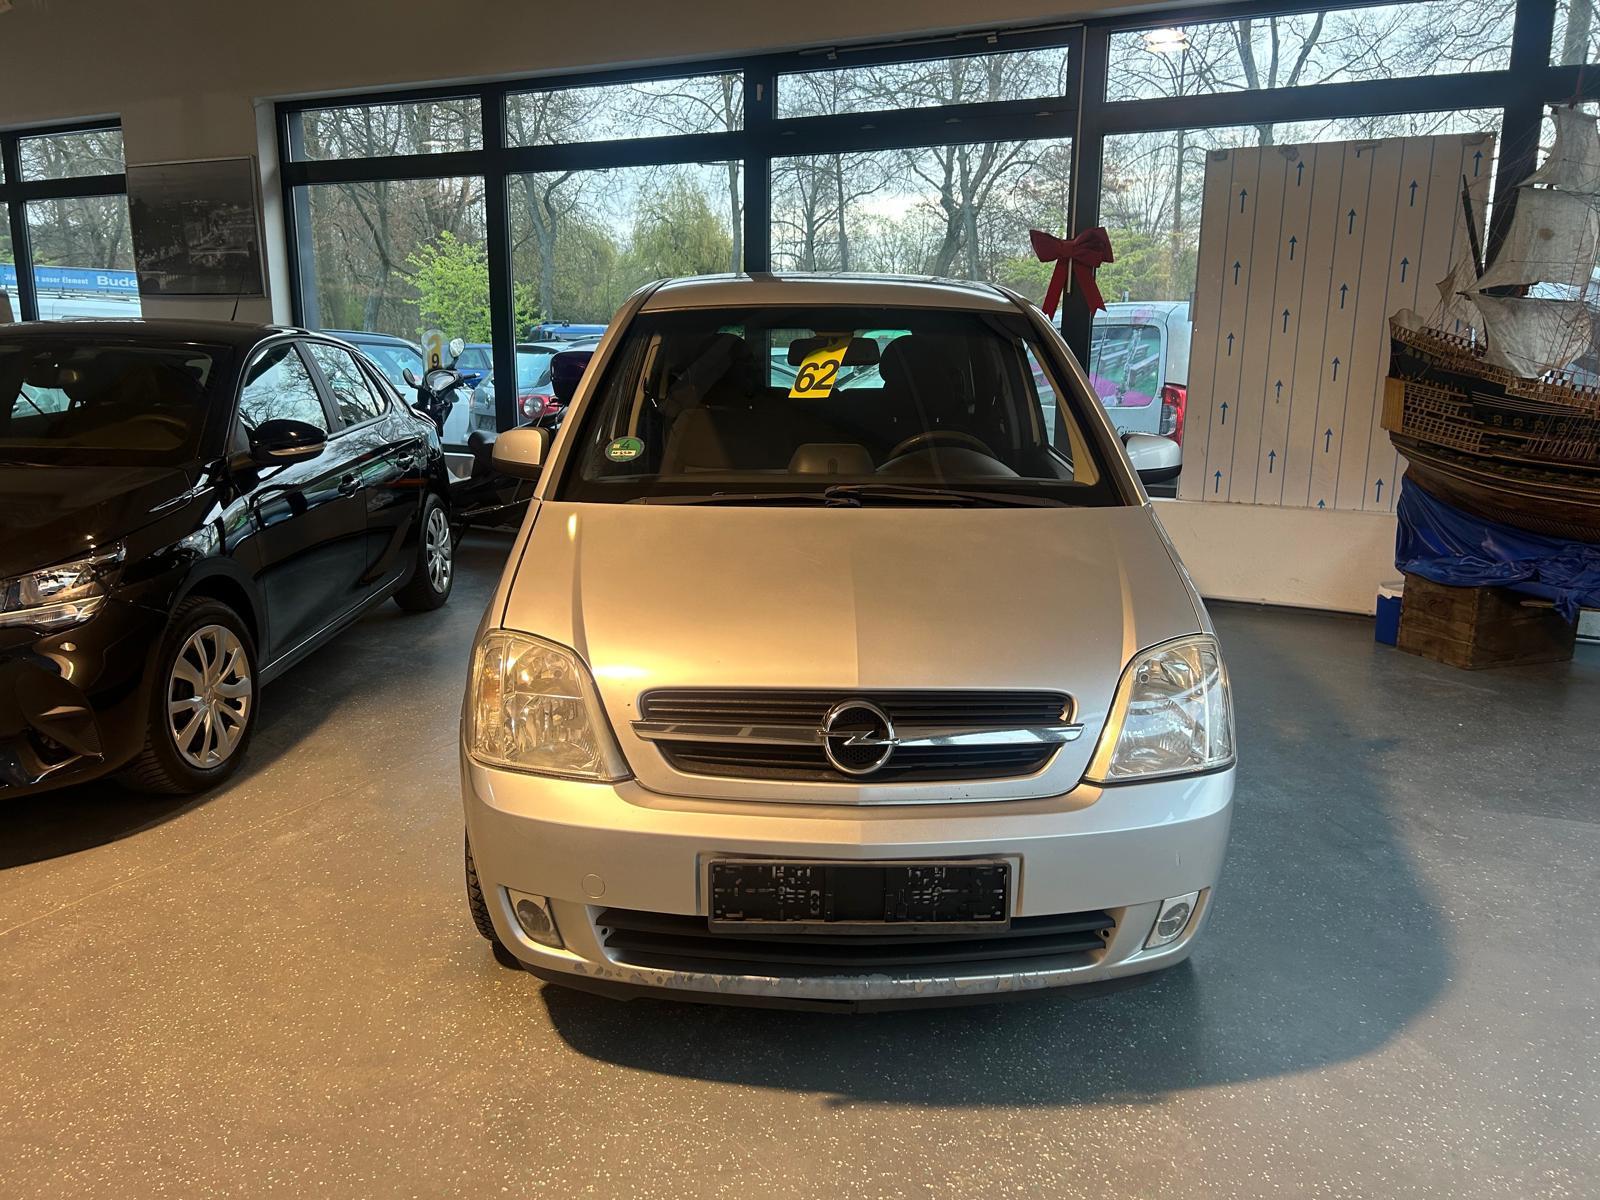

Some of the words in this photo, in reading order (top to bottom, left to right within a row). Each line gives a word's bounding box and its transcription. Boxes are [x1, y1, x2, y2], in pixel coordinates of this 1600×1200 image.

[62, 276, 88, 285] Element
[97, 275, 137, 287] Bude
[431, 353, 440, 369] 9
[794, 359, 840, 393] 62
